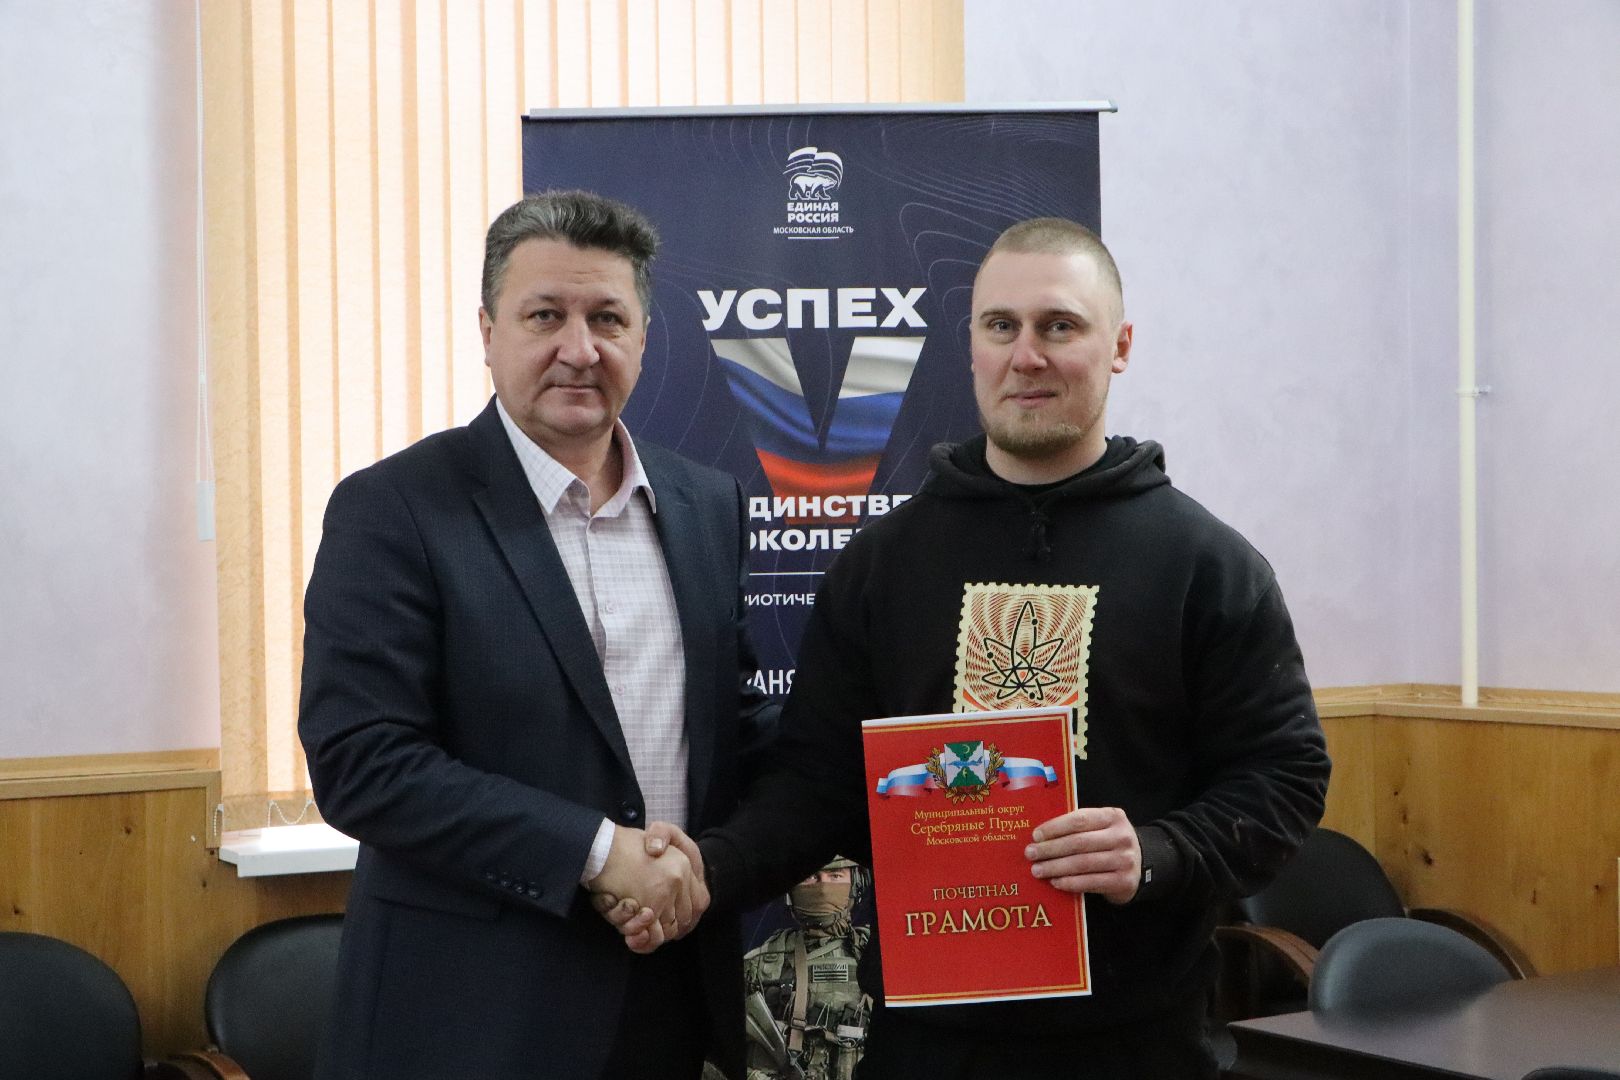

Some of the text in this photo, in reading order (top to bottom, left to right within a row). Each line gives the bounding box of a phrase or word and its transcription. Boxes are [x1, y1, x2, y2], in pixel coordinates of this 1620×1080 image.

[787, 202, 839, 212] ЕДИНАЯ
[787, 213, 839, 223] РОССИЯ
[773, 226, 854, 234] МОСКОВСКАЯ ОБЛАСТЬ
[697, 287, 928, 332] УСПЕХ
[744, 593, 816, 606] ИОТИЧЕ
[914, 805, 1025, 821] Муниципальный округ
[911, 817, 1030, 836] Серебряные Пруды
[926, 832, 1016, 846] Московской области
[932, 883, 1019, 901] ПОЧЕТНАЯ
[904, 903, 1053, 936] ГРАМОТА
